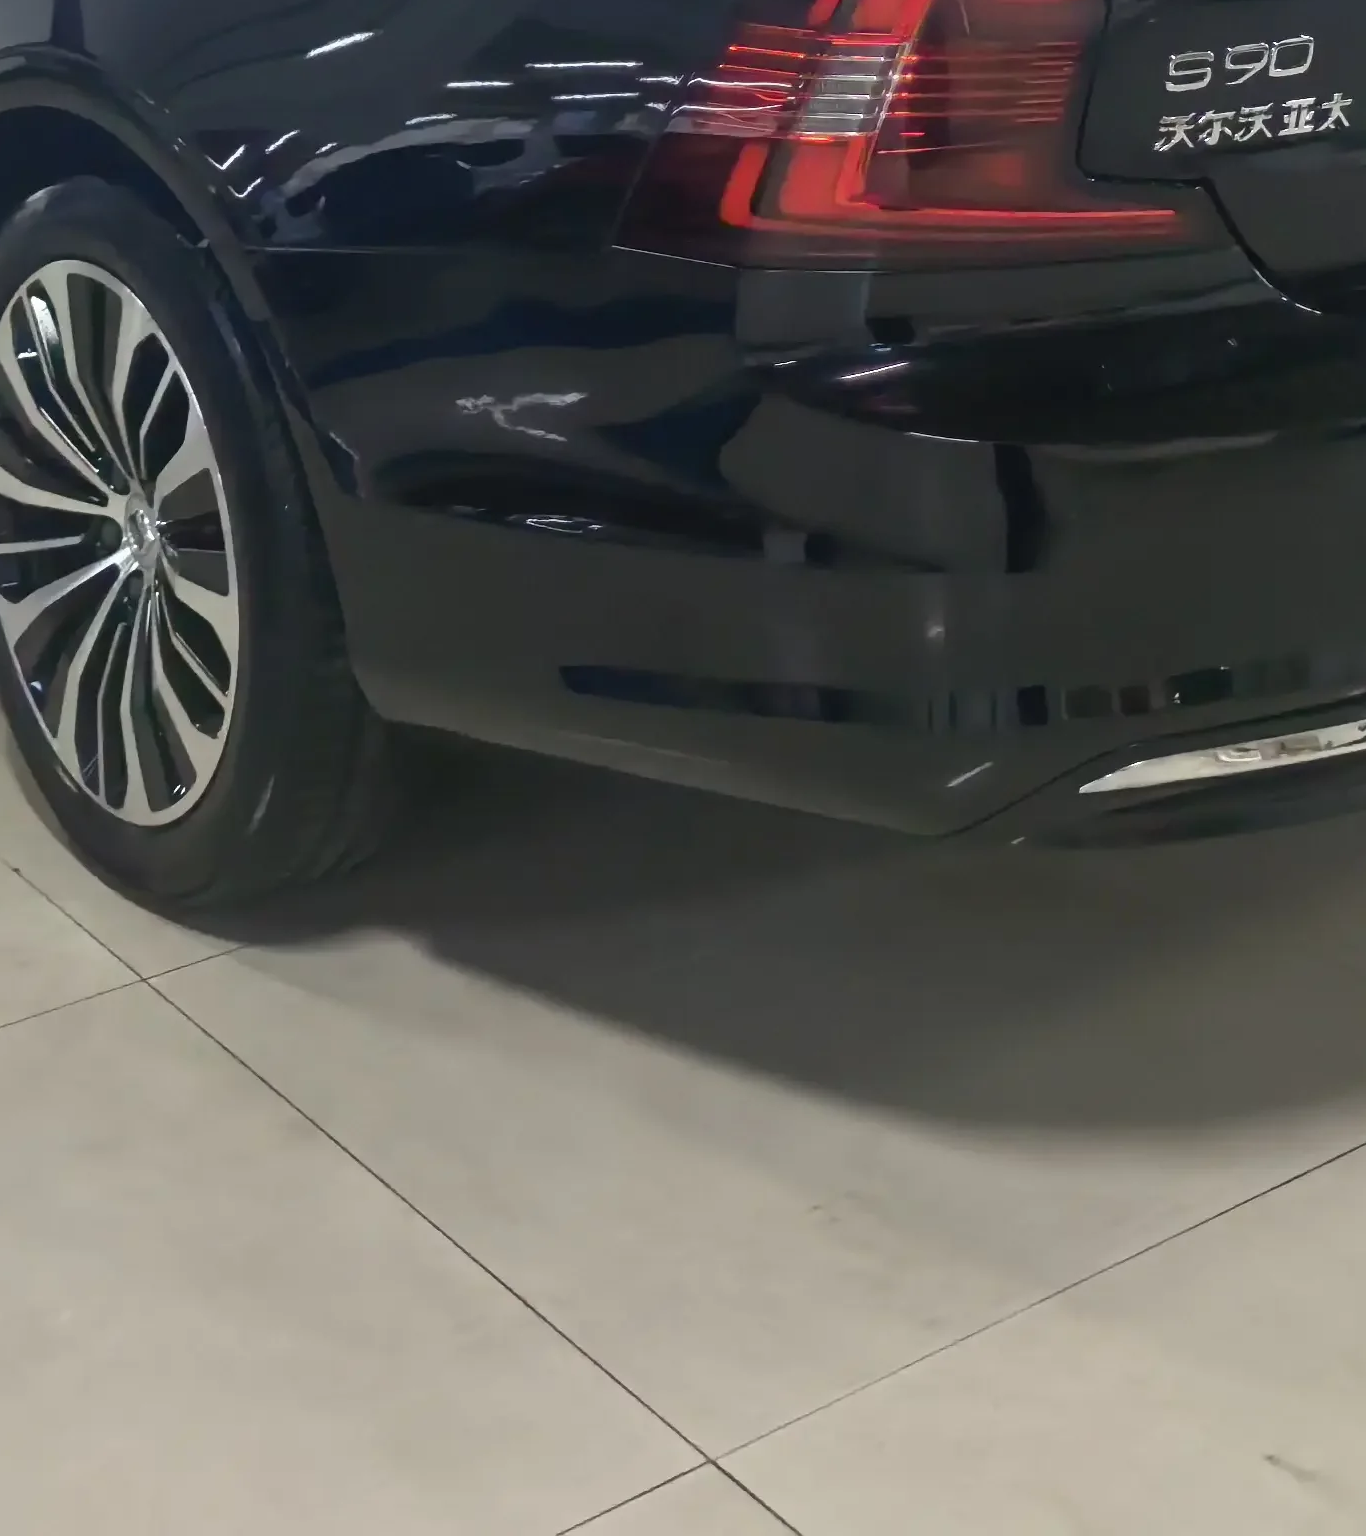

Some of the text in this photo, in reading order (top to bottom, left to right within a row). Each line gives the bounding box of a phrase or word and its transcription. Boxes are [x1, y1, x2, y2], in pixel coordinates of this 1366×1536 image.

[1164, 34, 1315, 92] S90
[1151, 92, 1354, 152] 沃尔沃亚太
